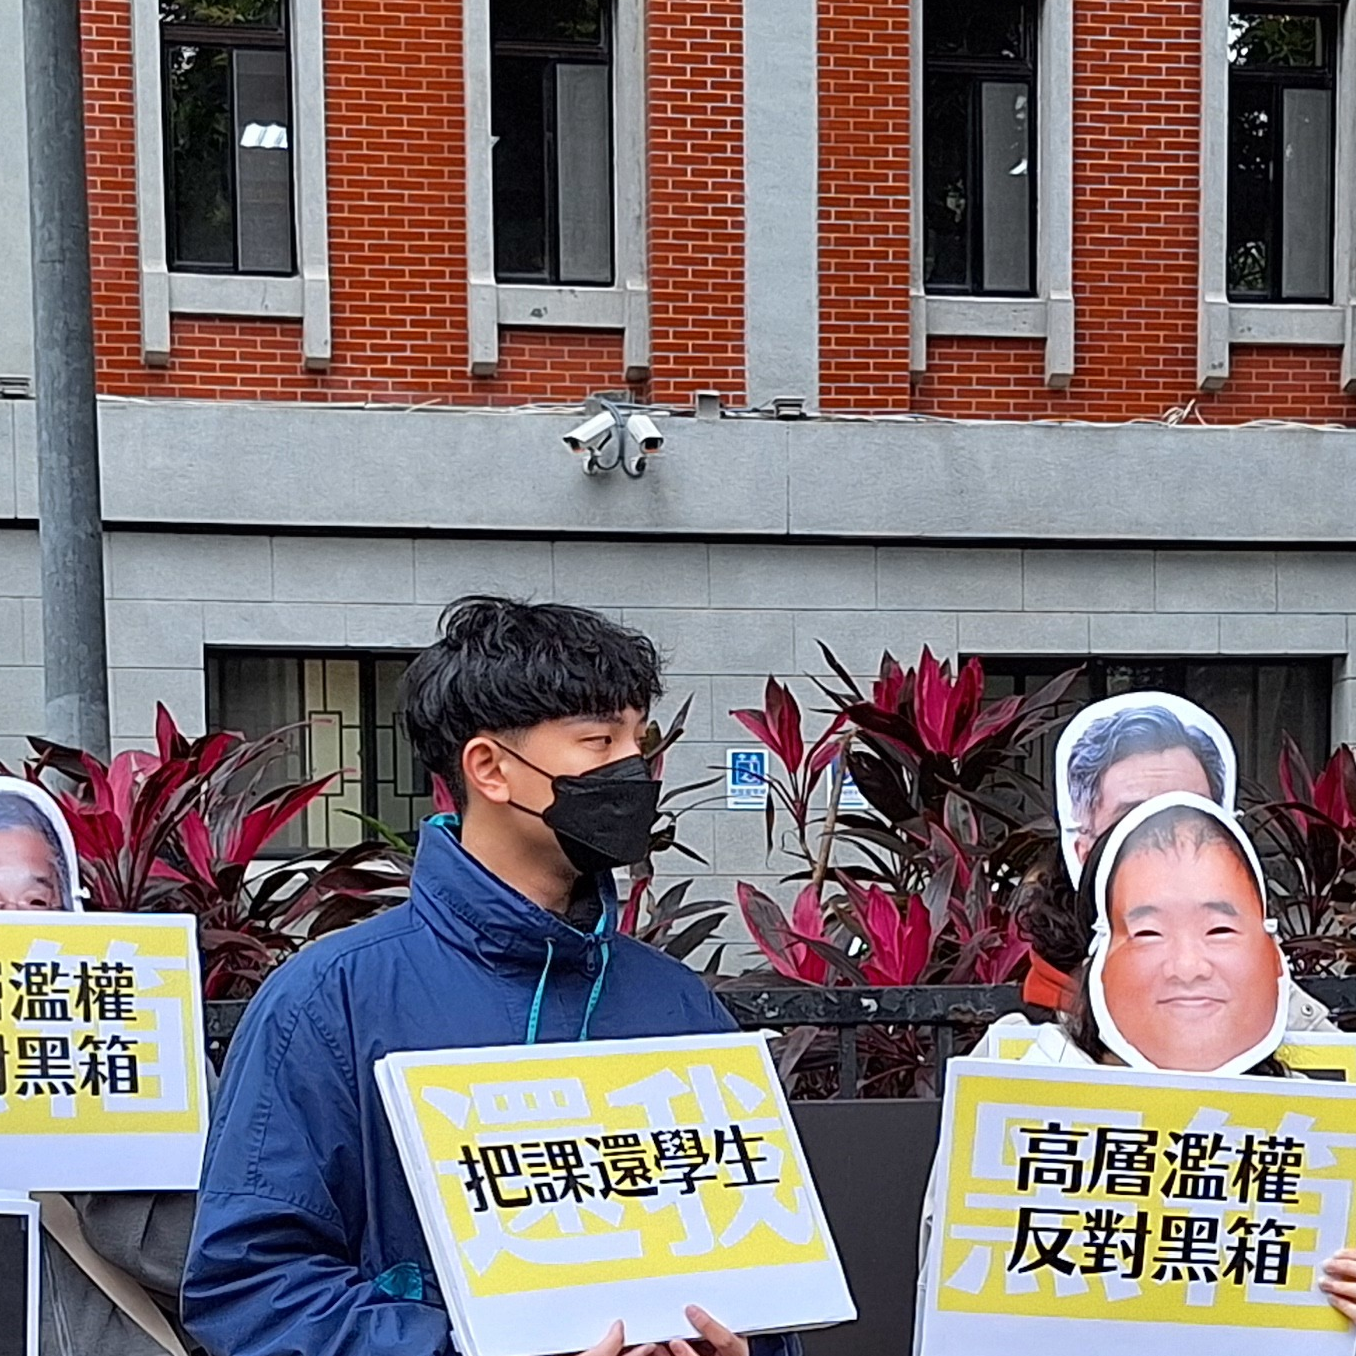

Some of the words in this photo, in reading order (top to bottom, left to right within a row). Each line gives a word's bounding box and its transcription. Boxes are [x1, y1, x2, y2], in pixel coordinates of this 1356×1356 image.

[458, 1123, 780, 1212] 把課還學生
[1015, 1121, 1305, 1205] 高層濫權
[1007, 1206, 1297, 1287] 反對黑箱
